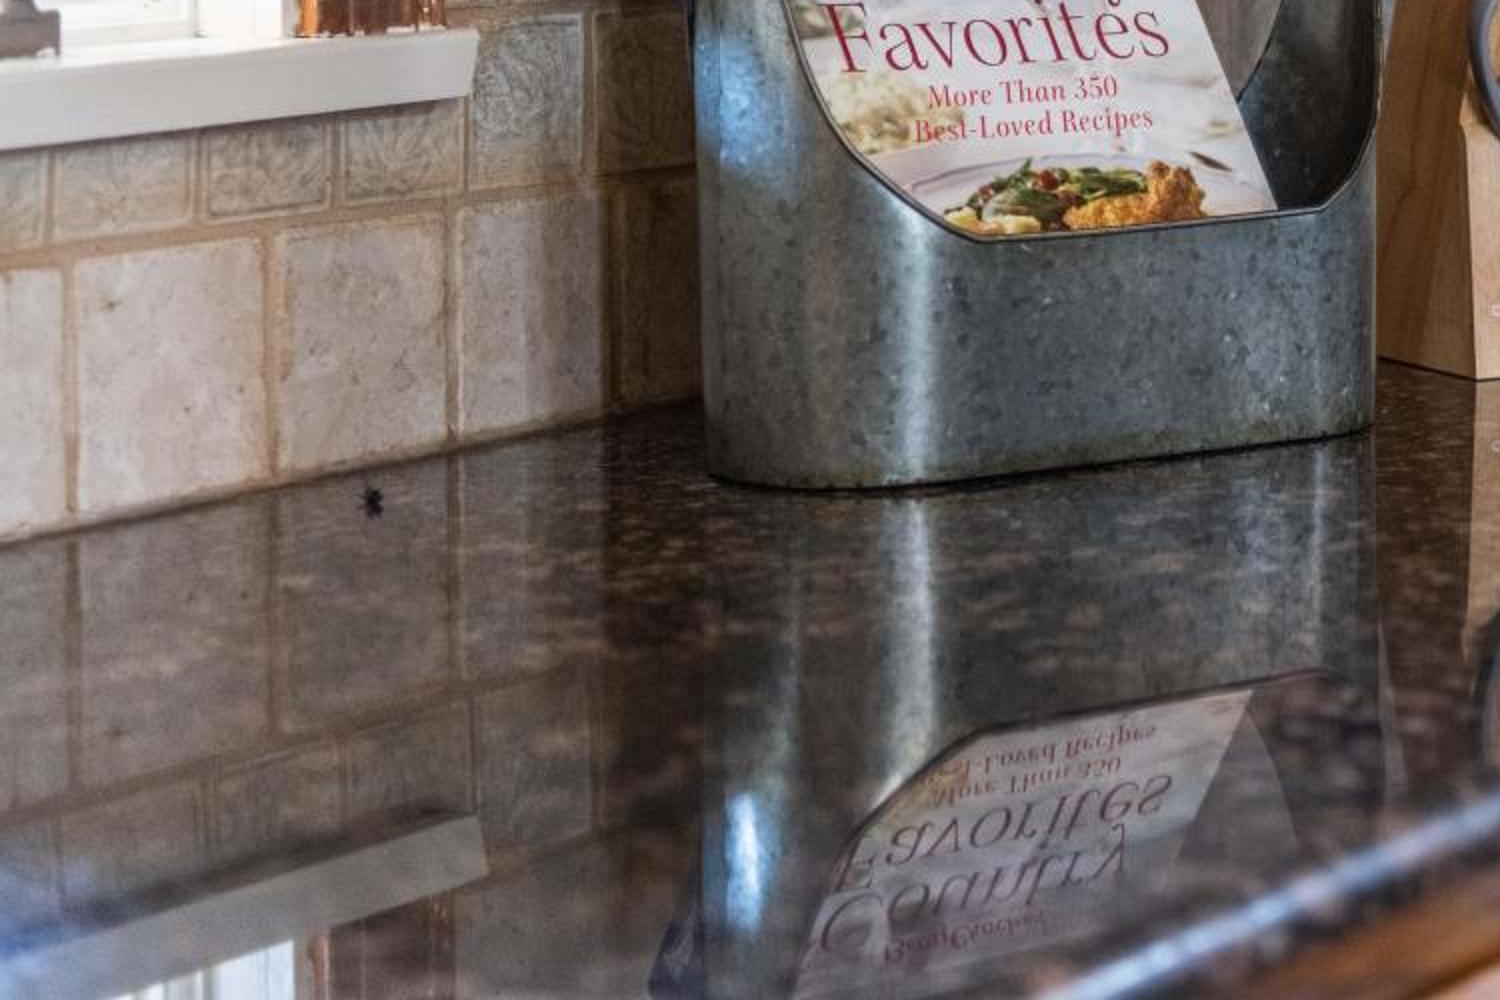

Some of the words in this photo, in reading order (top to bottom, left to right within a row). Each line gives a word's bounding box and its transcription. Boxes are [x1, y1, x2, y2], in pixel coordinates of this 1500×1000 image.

[928, 84, 992, 110] More
[1000, 79, 1066, 104] Than
[1074, 75, 1118, 100] 350
[913, 109, 1053, 143] Best-Loved
[1060, 106, 1153, 137] Recipes
